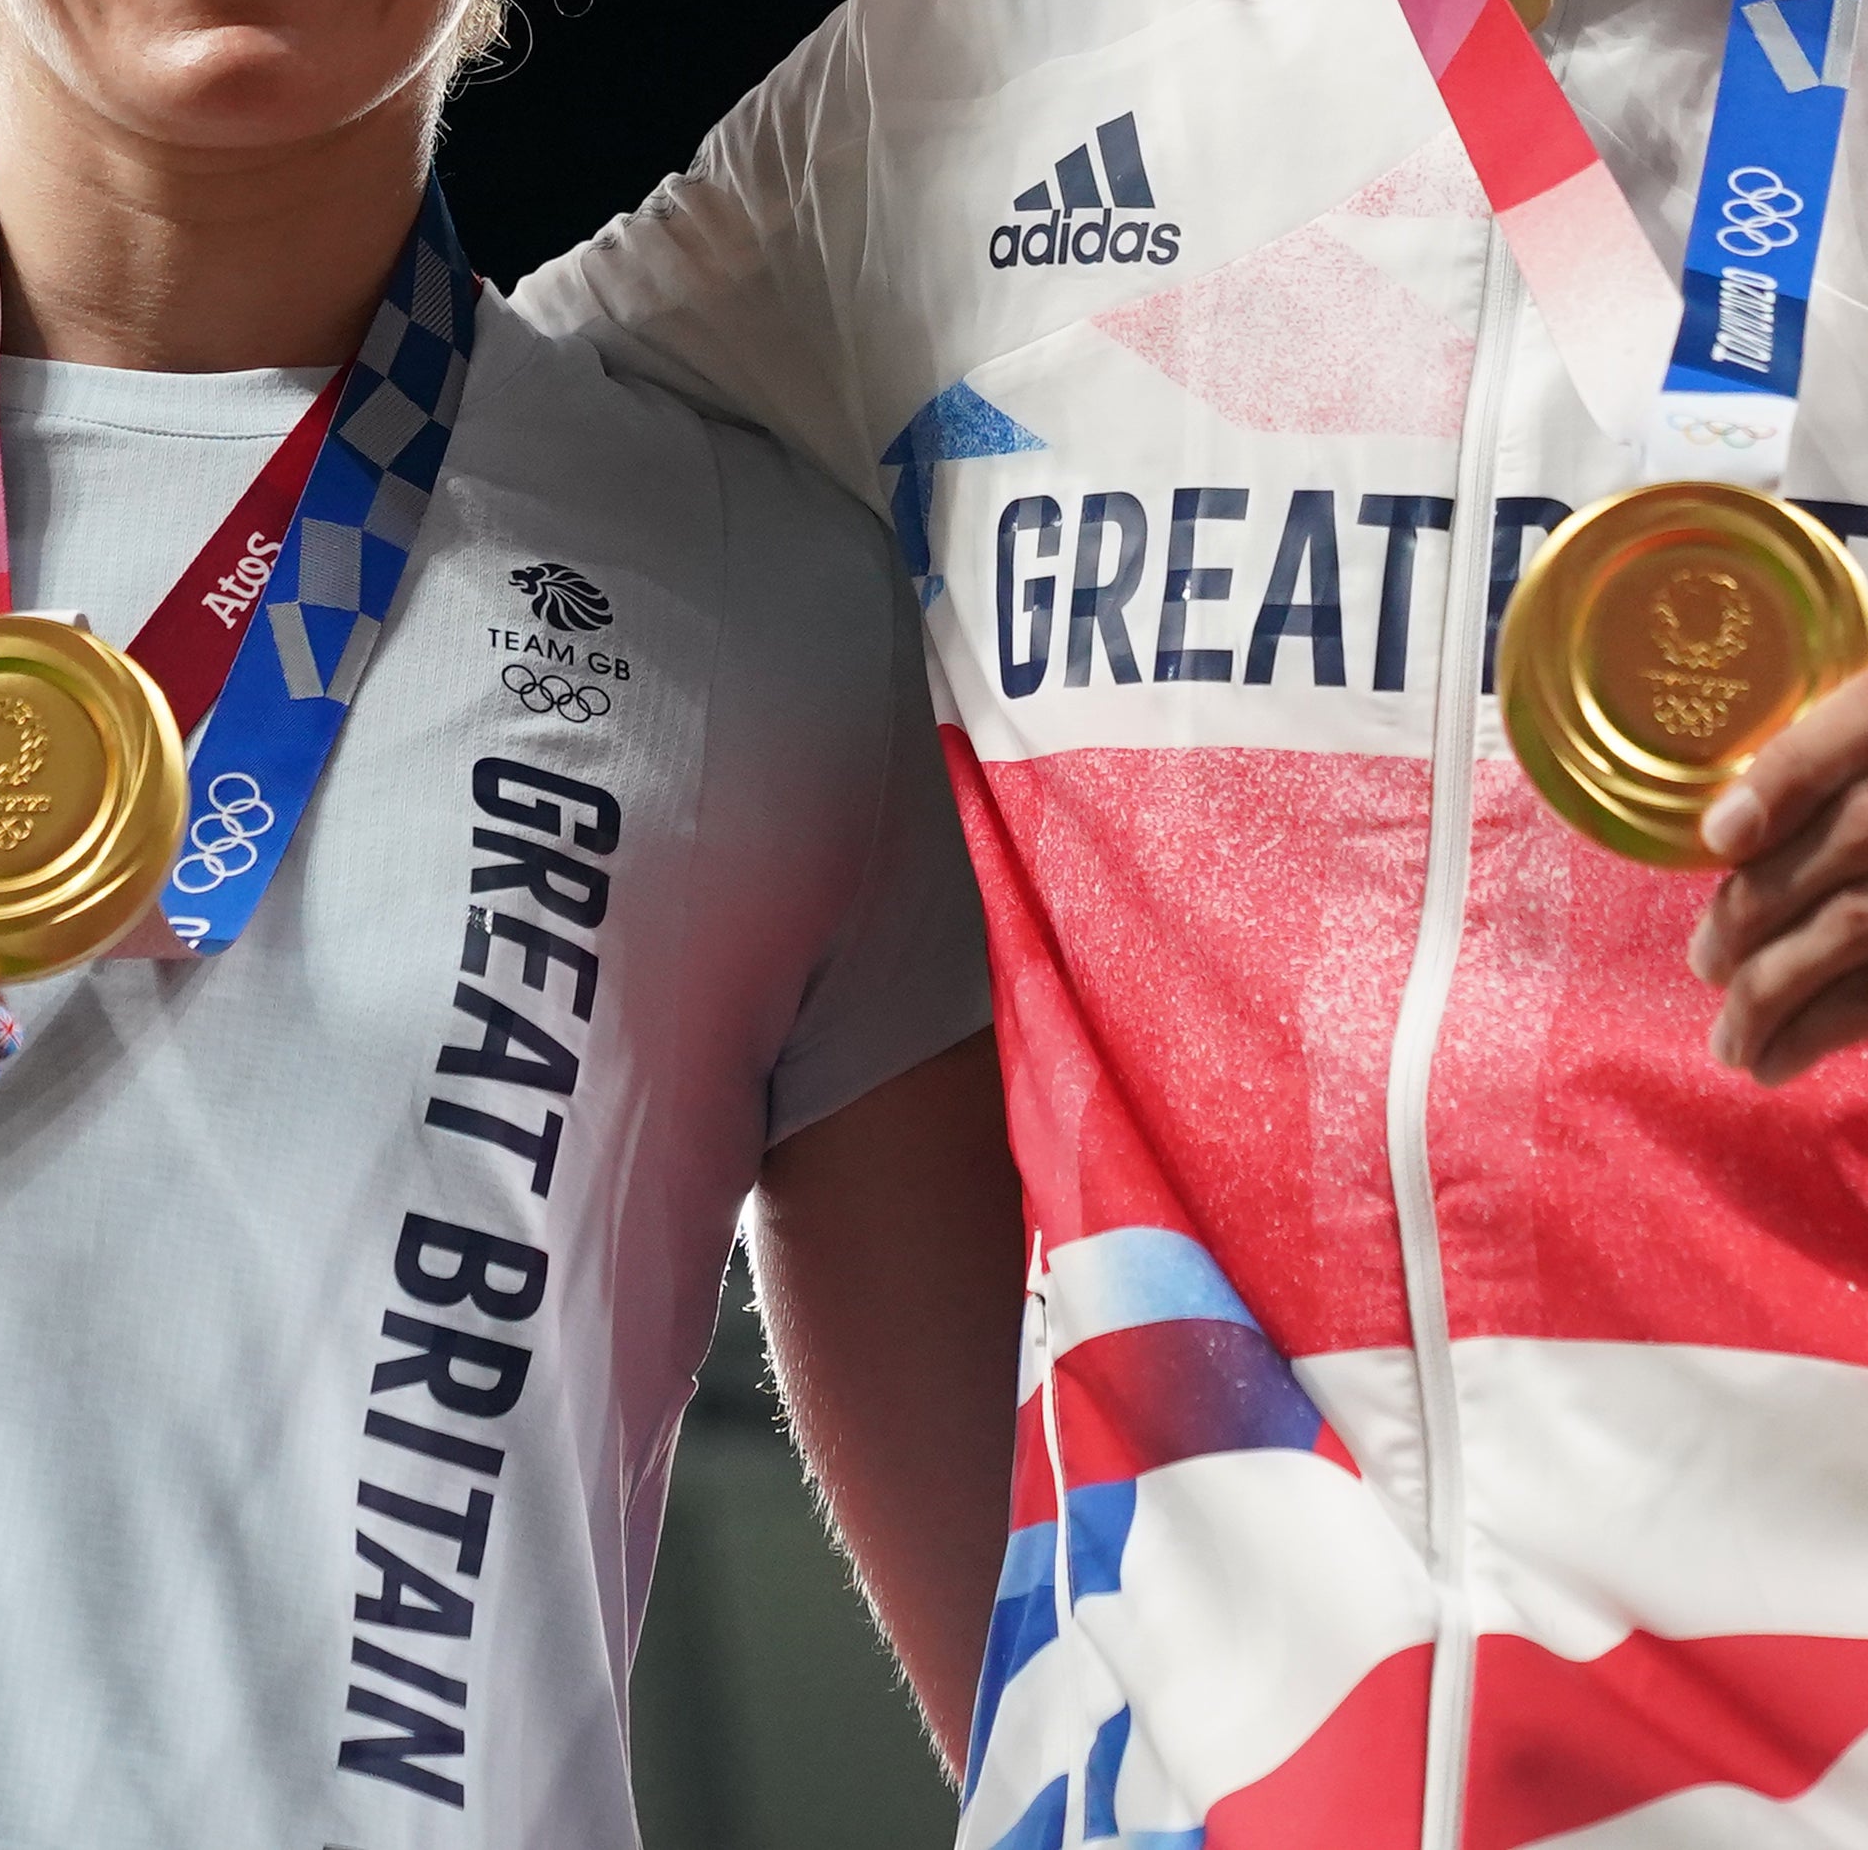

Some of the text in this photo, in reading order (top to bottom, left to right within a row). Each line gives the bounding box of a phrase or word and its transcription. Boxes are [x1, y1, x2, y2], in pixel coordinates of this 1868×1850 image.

[989, 208, 1181, 269] adidas
[201, 531, 282, 630] Atos
[997, 488, 1454, 699] GREAT
[487, 628, 630, 681] TEAM GB
[337, 757, 621, 1811] GREAT BRITAIN
